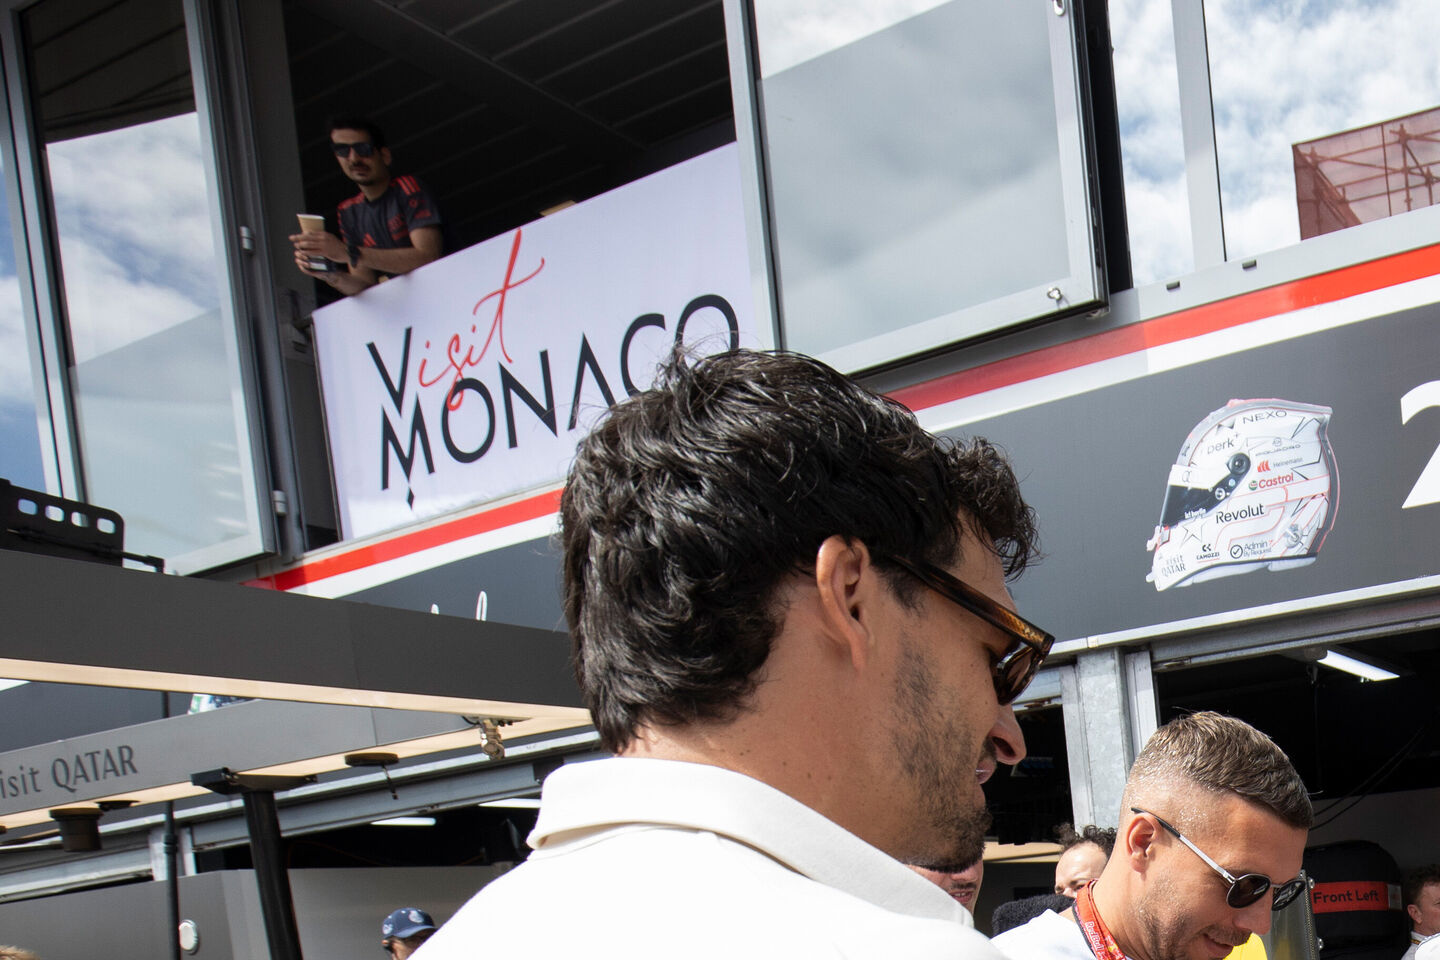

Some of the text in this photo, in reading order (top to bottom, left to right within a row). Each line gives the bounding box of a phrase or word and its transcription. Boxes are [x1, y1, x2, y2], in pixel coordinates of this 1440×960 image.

[366, 228, 545, 411] Visit
[381, 294, 740, 508] MONACO
[1243, 410, 1288, 425] NEXO
[1258, 473, 1294, 489] Castrol
[1215, 503, 1265, 524] Revolut
[1244, 540, 1268, 551] Admin
[1196, 552, 1220, 560] CAMOZZI
[1161, 563, 1186, 578] QATAR
[0, 745, 138, 799] isit QATAR
[1313, 889, 1379, 904] Front Left
